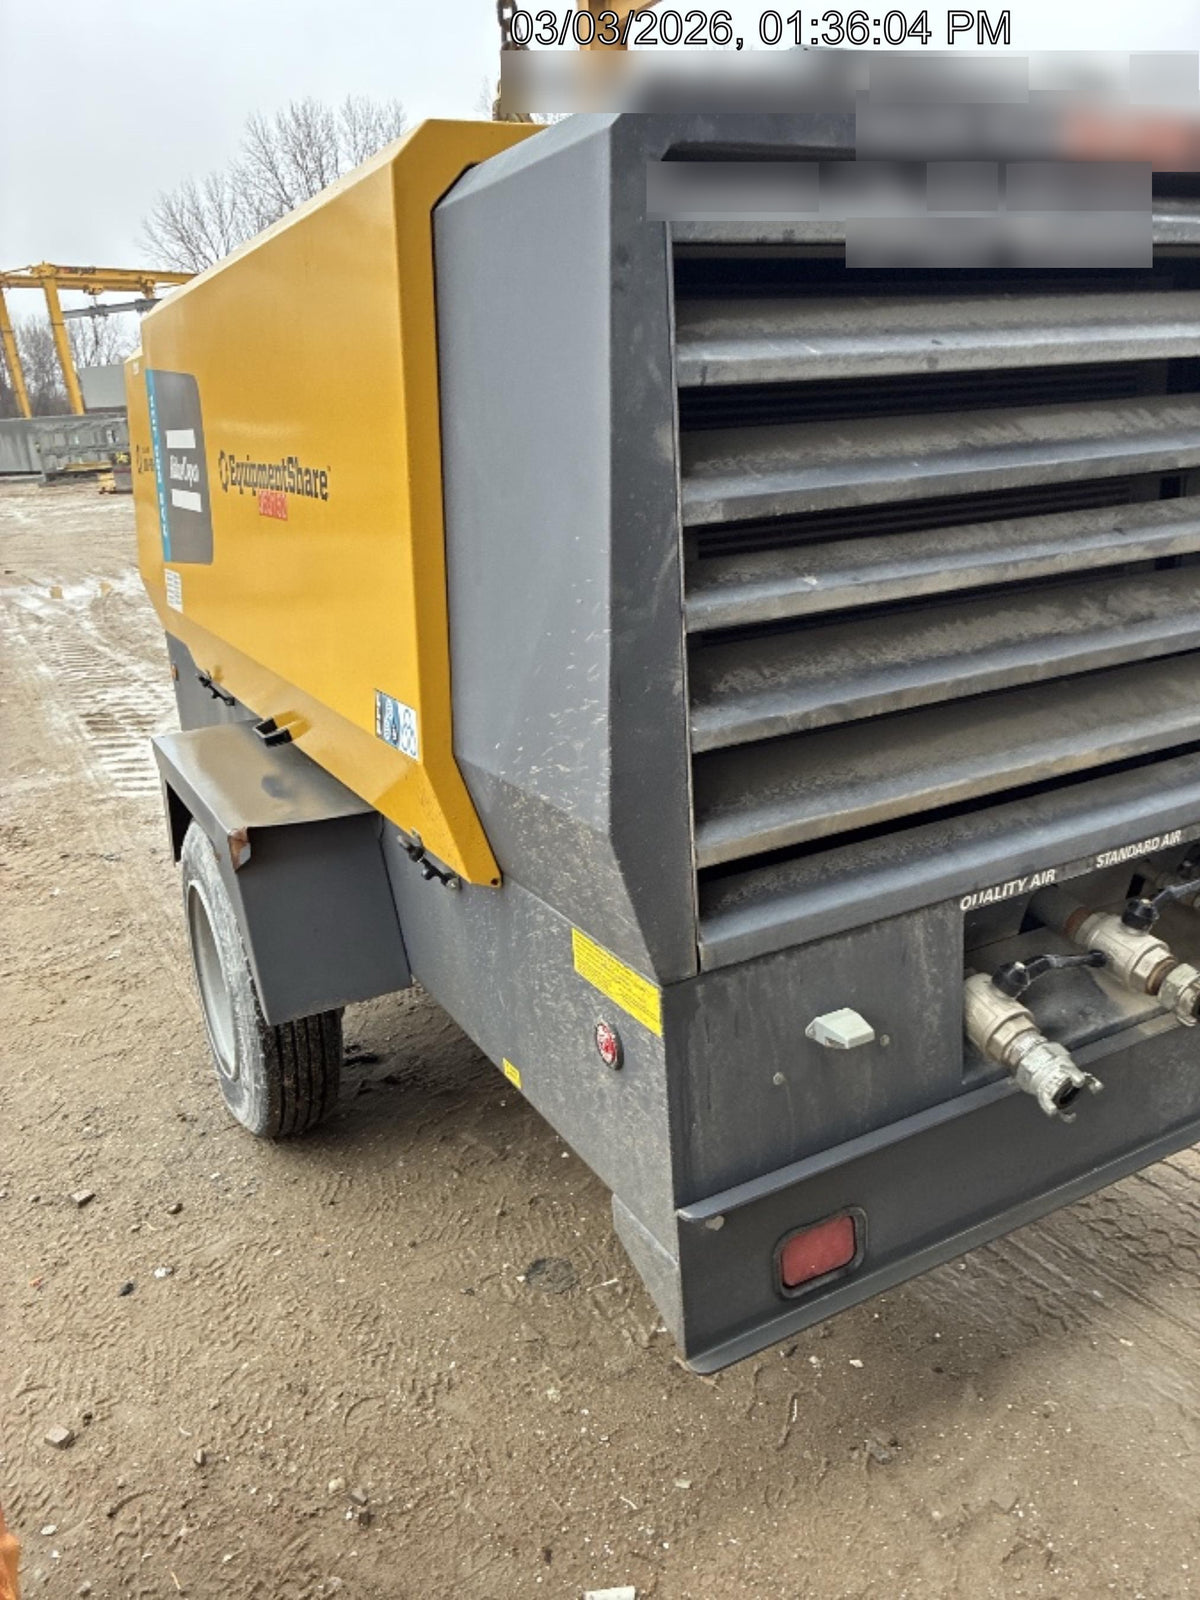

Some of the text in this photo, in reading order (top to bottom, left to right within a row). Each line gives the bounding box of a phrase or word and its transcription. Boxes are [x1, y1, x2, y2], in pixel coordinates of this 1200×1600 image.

[229, 454, 328, 502] EquipmentShare
[1096, 830, 1182, 868] STANDARD AIR
[960, 869, 1056, 911] QUALITY AIR
